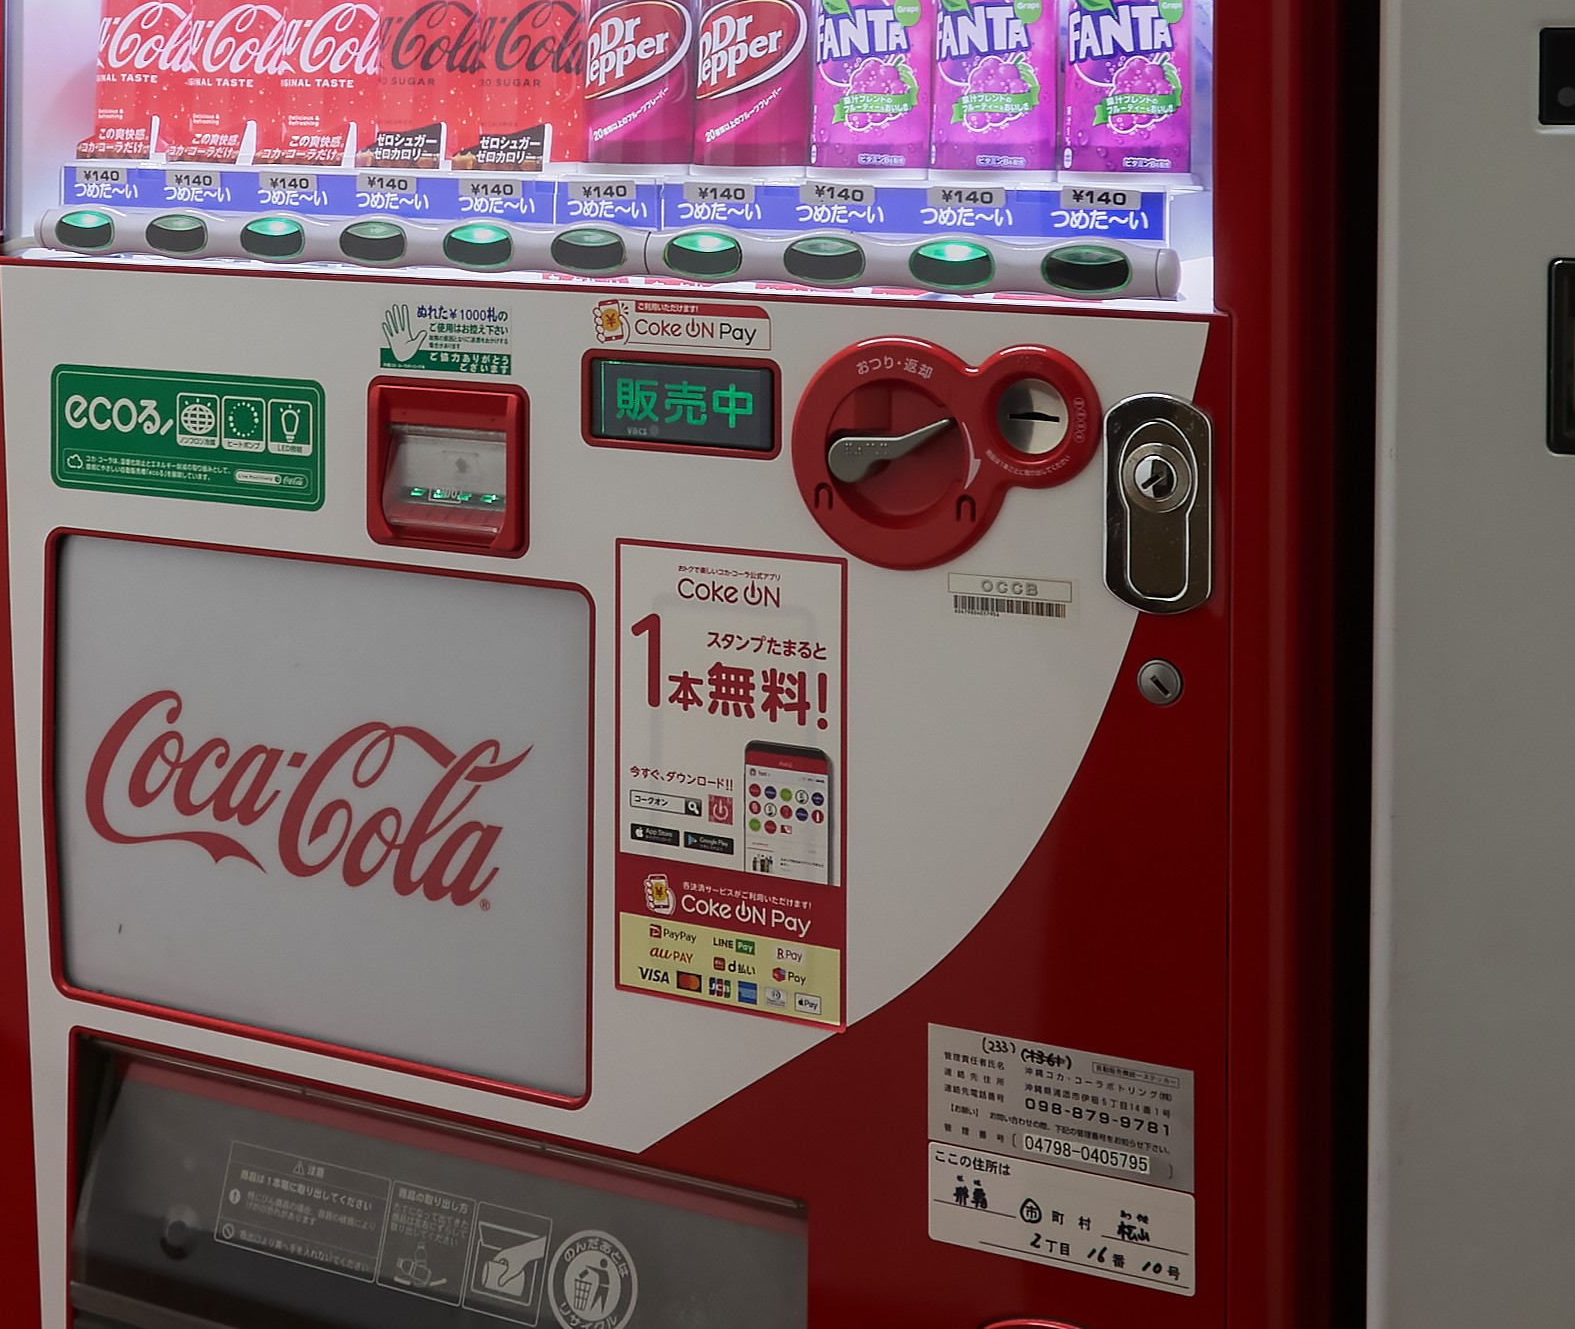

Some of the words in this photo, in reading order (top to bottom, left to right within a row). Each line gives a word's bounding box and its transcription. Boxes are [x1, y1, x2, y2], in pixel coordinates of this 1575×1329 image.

[601, 14, 640, 42] Dr
[819, 7, 907, 61] FANTA
[1070, 5, 1172, 63] FANTA
[121, 74, 157, 83] TASTE
[496, 78, 541, 87] SUGAR
[377, 135, 437, 148] ゼロシュガー
[270, 177, 309, 190] ¥140
[471, 182, 513, 197] ¥140
[942, 189, 993, 204] ¥140
[634, 317, 683, 337] Coke
[719, 323, 757, 346] Pay
[617, 378, 753, 429] 販売中
[678, 578, 738, 604] Coke
[707, 632, 826, 660] スタンプたまると
[86, 689, 534, 908] Coca-Cola
[681, 894, 732, 920] Coke
[771, 910, 812, 938] Pay
[663, 928, 697, 943] PayPay
[713, 937, 734, 950] LINE
[736, 943, 755, 954] Pay
[638, 966, 671, 984] VISA
[1025, 1098, 1170, 1136] 098-879-9781
[934, 1150, 1011, 1176] ここの住所は
[1025, 1135, 1148, 1173] 04798-0405795
